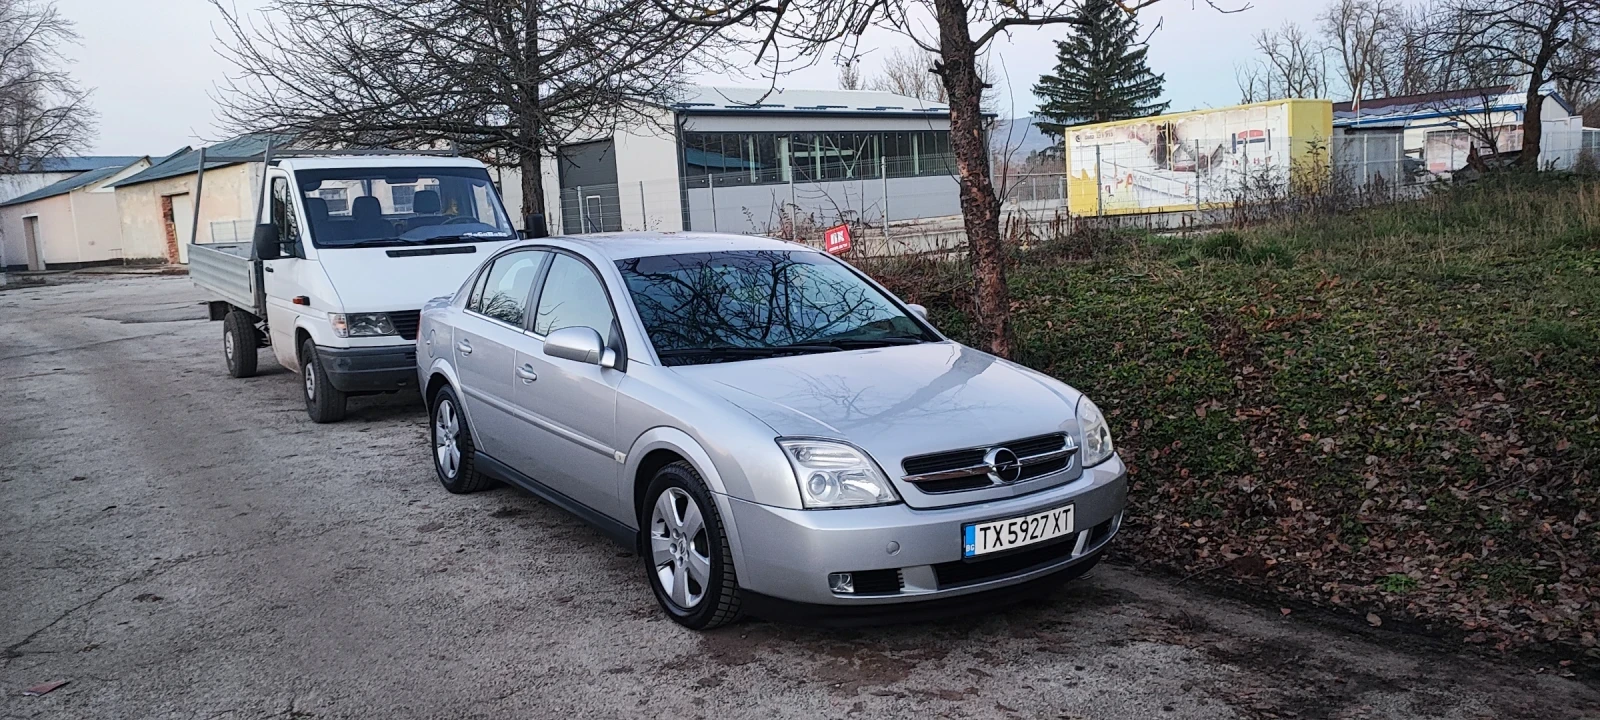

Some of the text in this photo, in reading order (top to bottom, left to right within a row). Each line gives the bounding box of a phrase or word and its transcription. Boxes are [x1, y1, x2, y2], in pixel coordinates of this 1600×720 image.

[979, 508, 1071, 550] TX 5927 XT
[965, 544, 975, 552] BG
